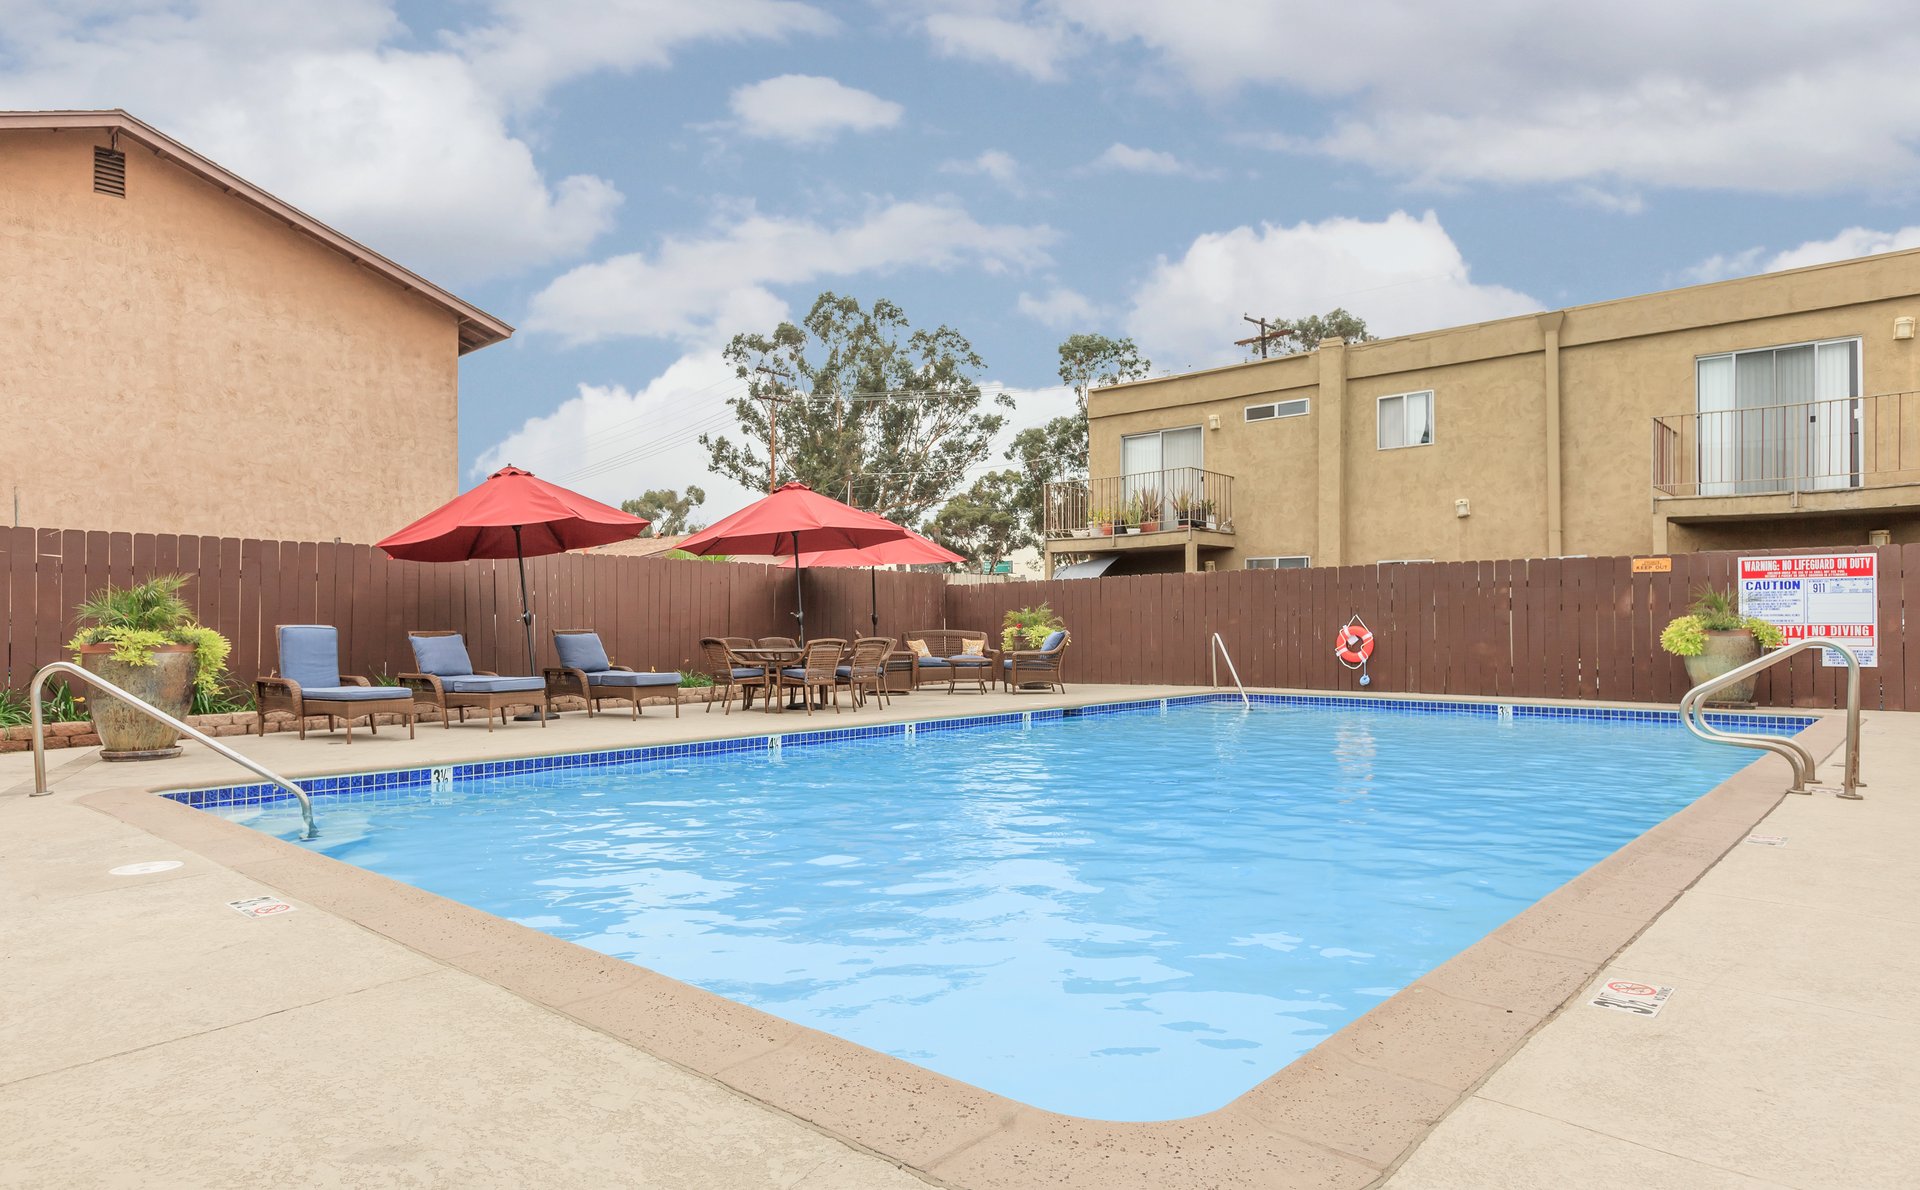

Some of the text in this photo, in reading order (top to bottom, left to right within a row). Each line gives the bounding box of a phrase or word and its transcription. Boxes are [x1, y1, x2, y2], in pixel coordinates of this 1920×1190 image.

[1744, 557, 1870, 572] WARNING: NO LIFEGUARD ON DUTY
[1746, 580, 1800, 591] CAUTION
[1812, 583, 1826, 593] 911
[1812, 625, 1869, 636] NO DIVING
